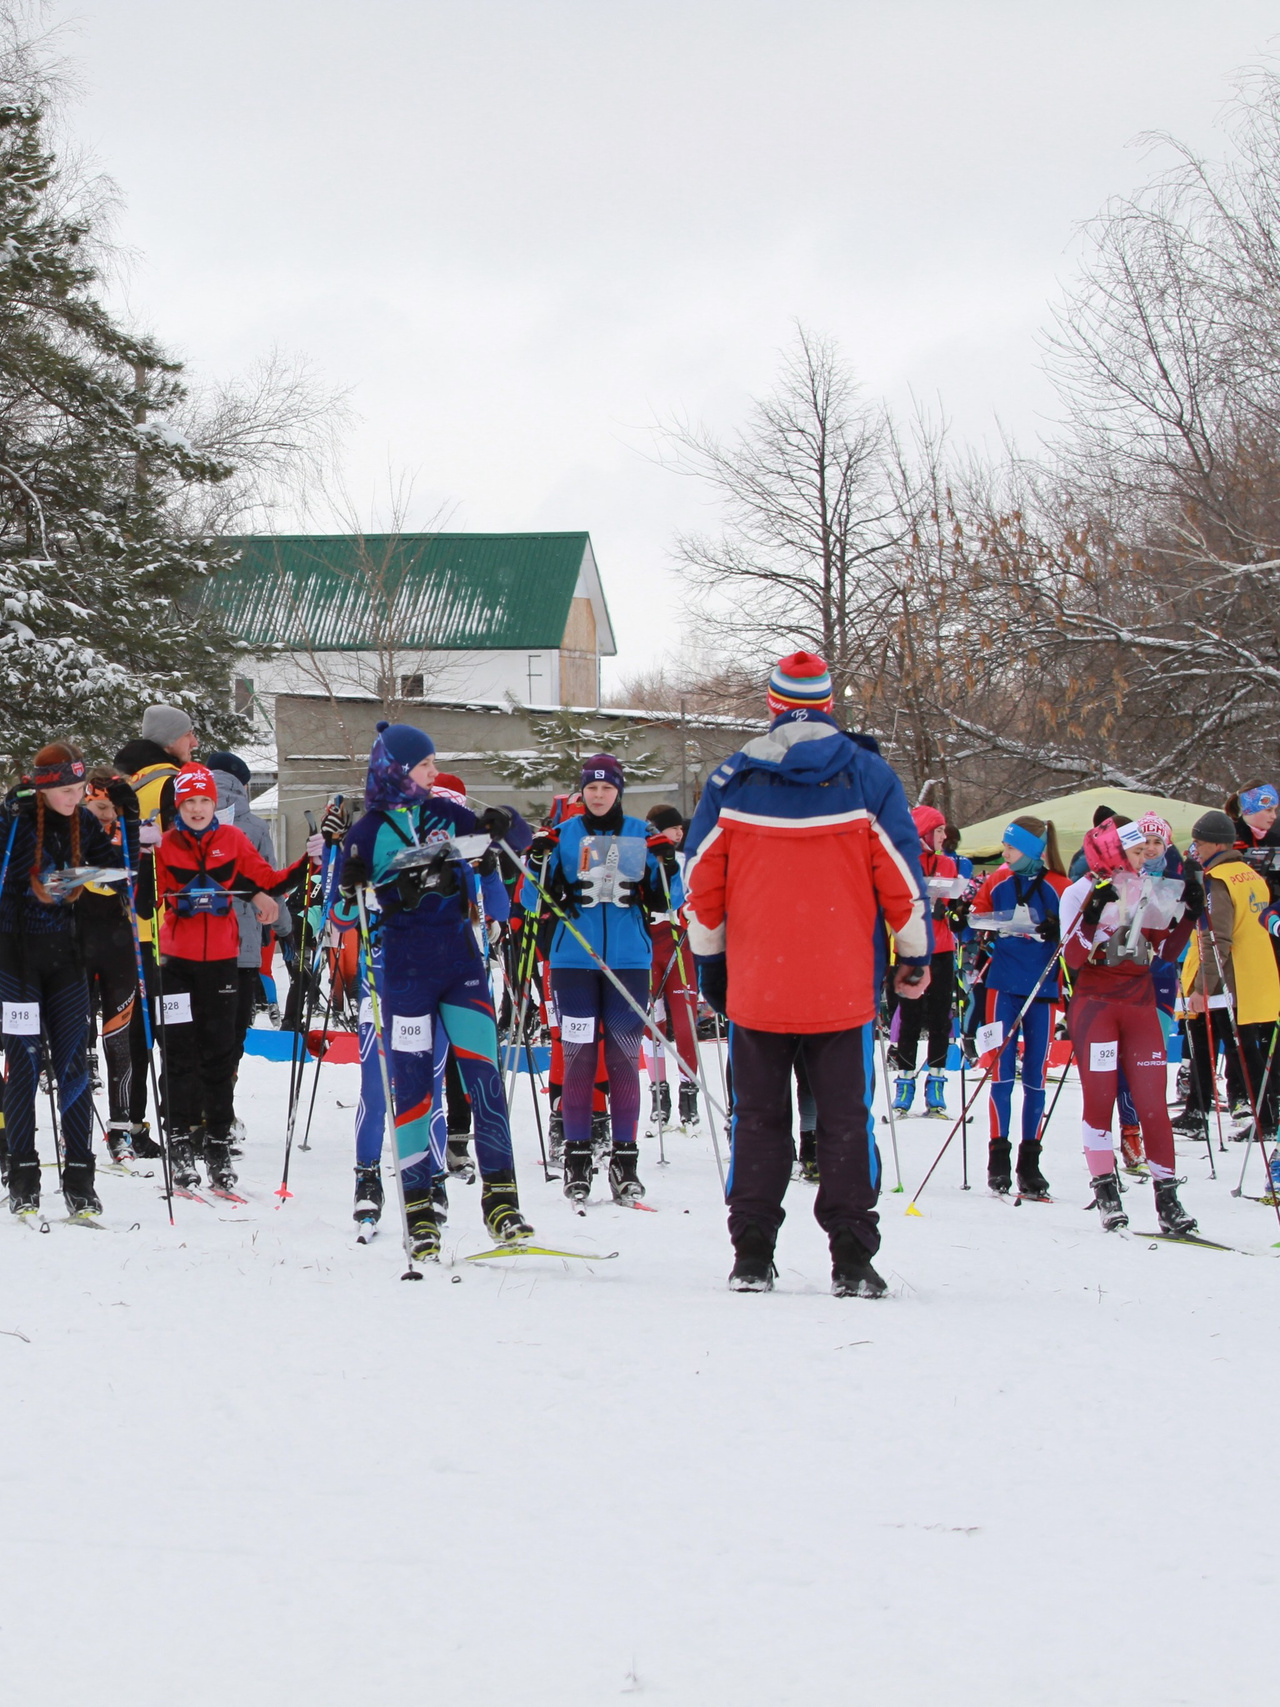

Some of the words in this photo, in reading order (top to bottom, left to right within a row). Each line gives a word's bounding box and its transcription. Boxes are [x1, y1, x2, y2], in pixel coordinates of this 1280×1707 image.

[162, 1001, 180, 1011] 928
[11, 1011, 30, 1020] 918
[400, 1025, 422, 1036] 908
[570, 1022, 588, 1032] 927
[1100, 1049, 1115, 1058] 926
